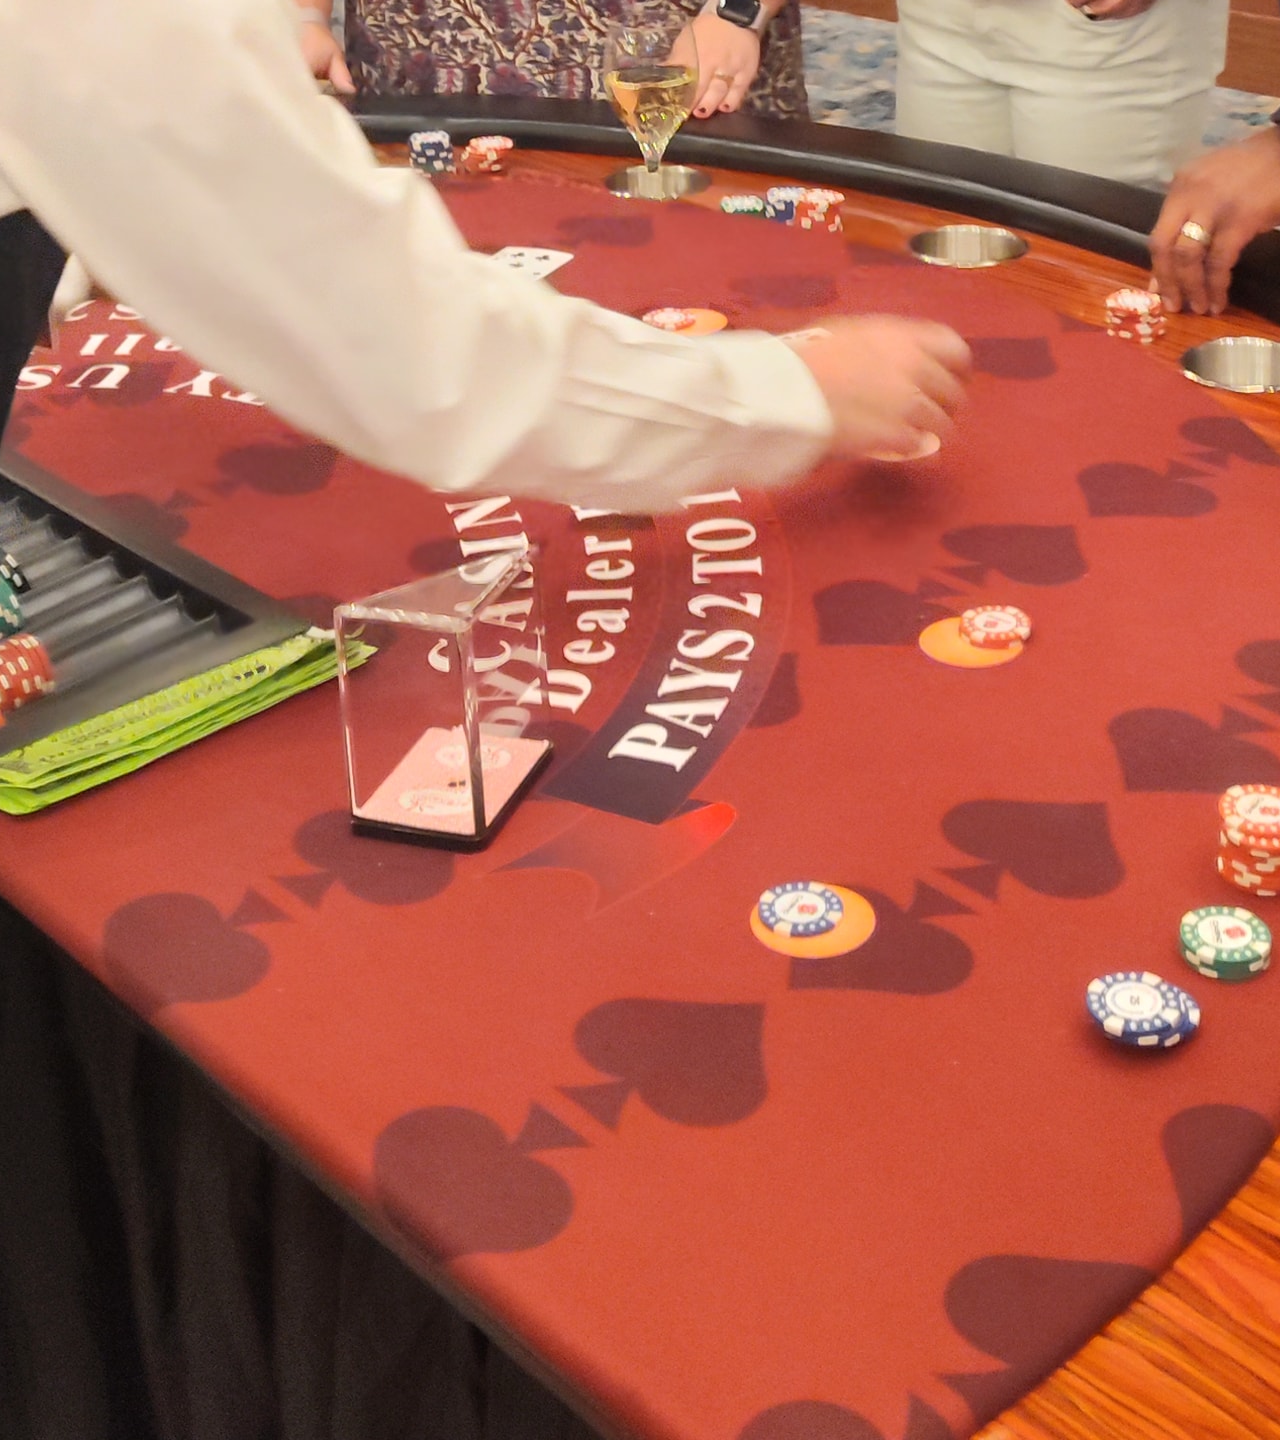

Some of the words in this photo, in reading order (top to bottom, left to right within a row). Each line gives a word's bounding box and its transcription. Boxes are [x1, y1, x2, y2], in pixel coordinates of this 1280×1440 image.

[15, 363, 131, 390] US
[428, 495, 535, 673] CASIN
[685, 517, 763, 585] TO
[516, 535, 636, 714] Dealer
[687, 592, 763, 619] 2
[607, 629, 756, 773] PAYS
